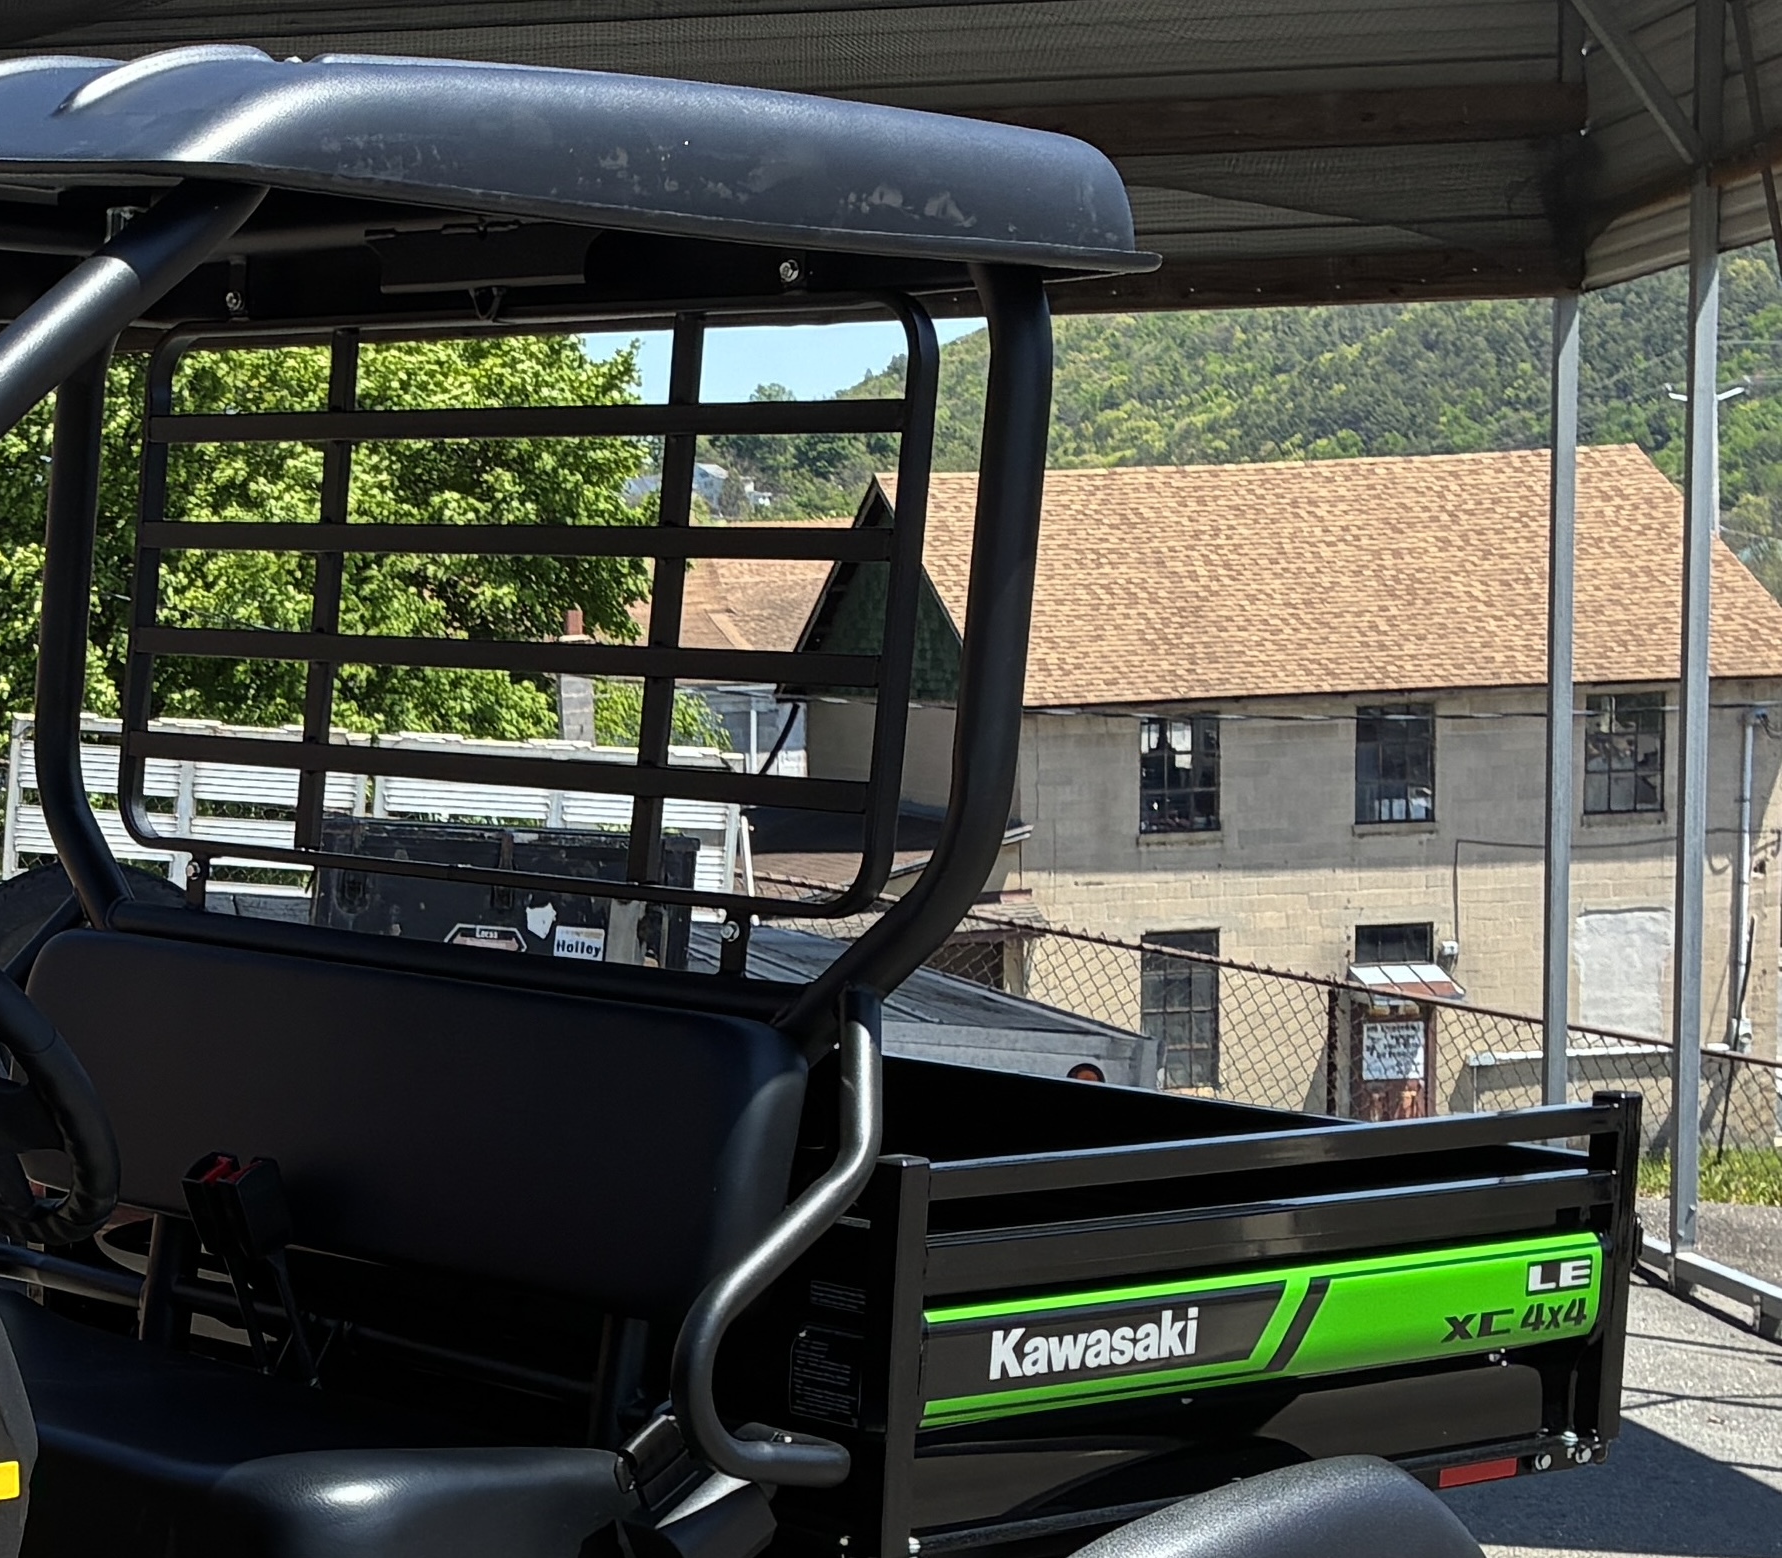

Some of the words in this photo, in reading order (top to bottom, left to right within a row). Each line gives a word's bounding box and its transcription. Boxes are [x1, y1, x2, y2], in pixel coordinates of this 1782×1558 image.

[556, 939, 602, 958] Holley
[1527, 1259, 1592, 1293] LE
[1441, 1308, 1516, 1344] XC
[1518, 1297, 1589, 1332] 4x4
[988, 1306, 1200, 1382] Kawasaki
